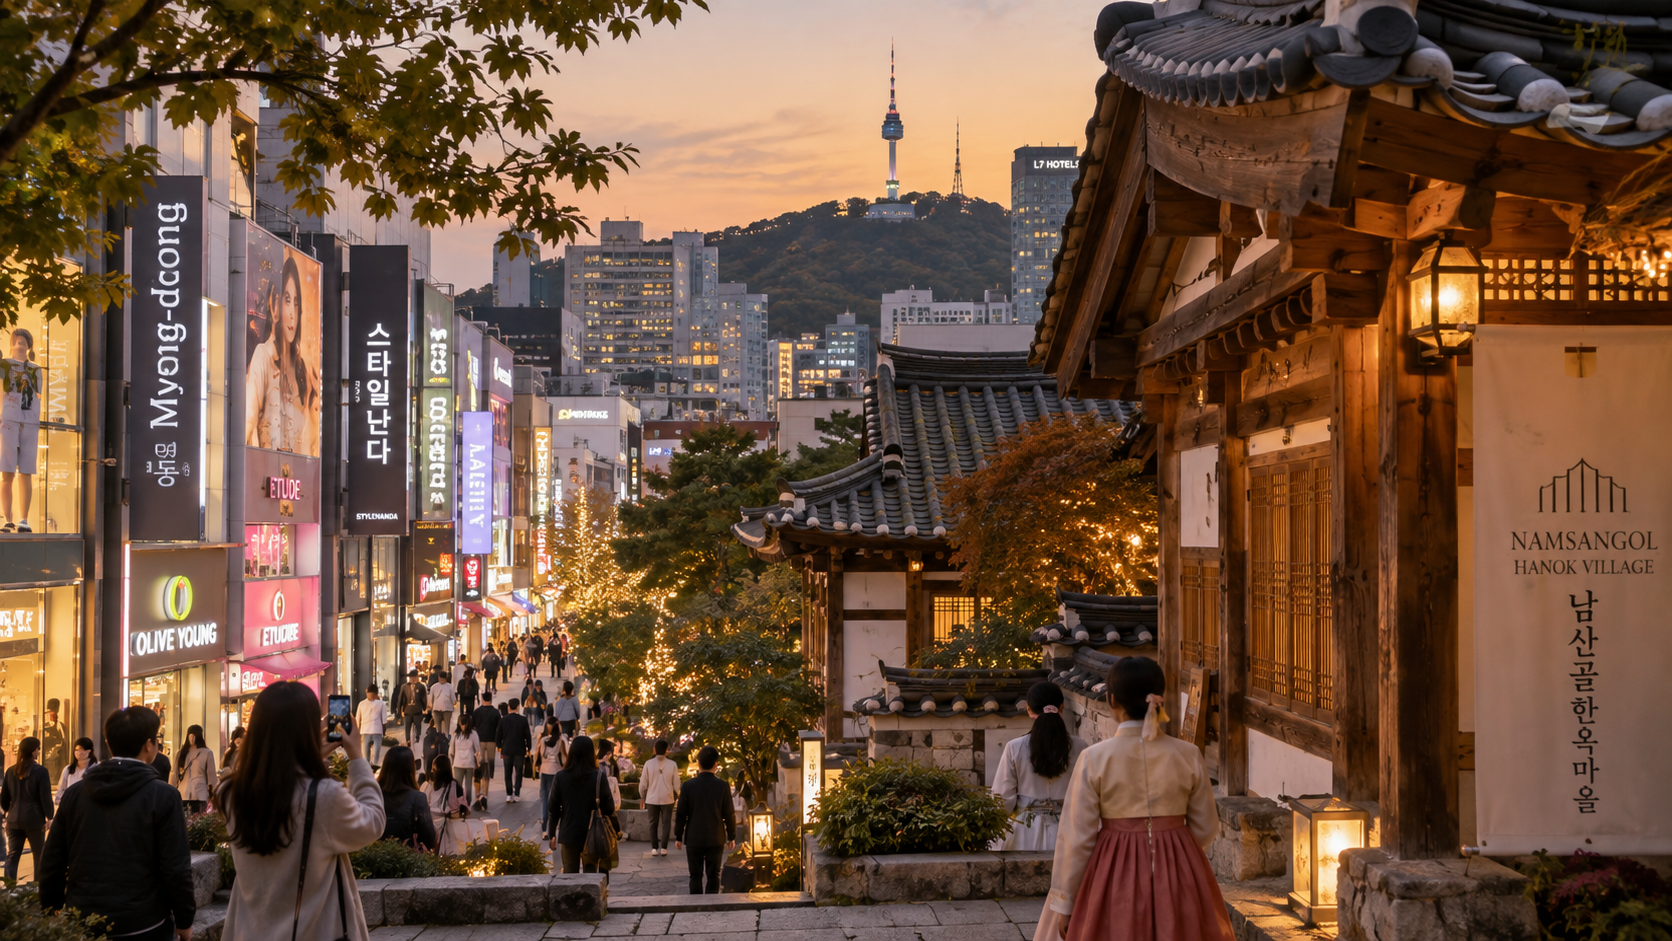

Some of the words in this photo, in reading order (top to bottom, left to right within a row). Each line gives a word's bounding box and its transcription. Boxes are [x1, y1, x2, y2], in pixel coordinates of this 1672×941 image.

[1033, 160, 1045, 169] L7
[366, 322, 392, 465] 스타일난다
[270, 476, 301, 500] ETUDE
[1511, 531, 1659, 551] NAMSANGOL
[1514, 559, 1577, 575] HANOK
[1582, 559, 1655, 575] VILLAGE
[135, 628, 175, 656] OLIVE
[177, 622, 217, 649] YOUNG
[1567, 589, 1600, 814] 남산골한옥마을
